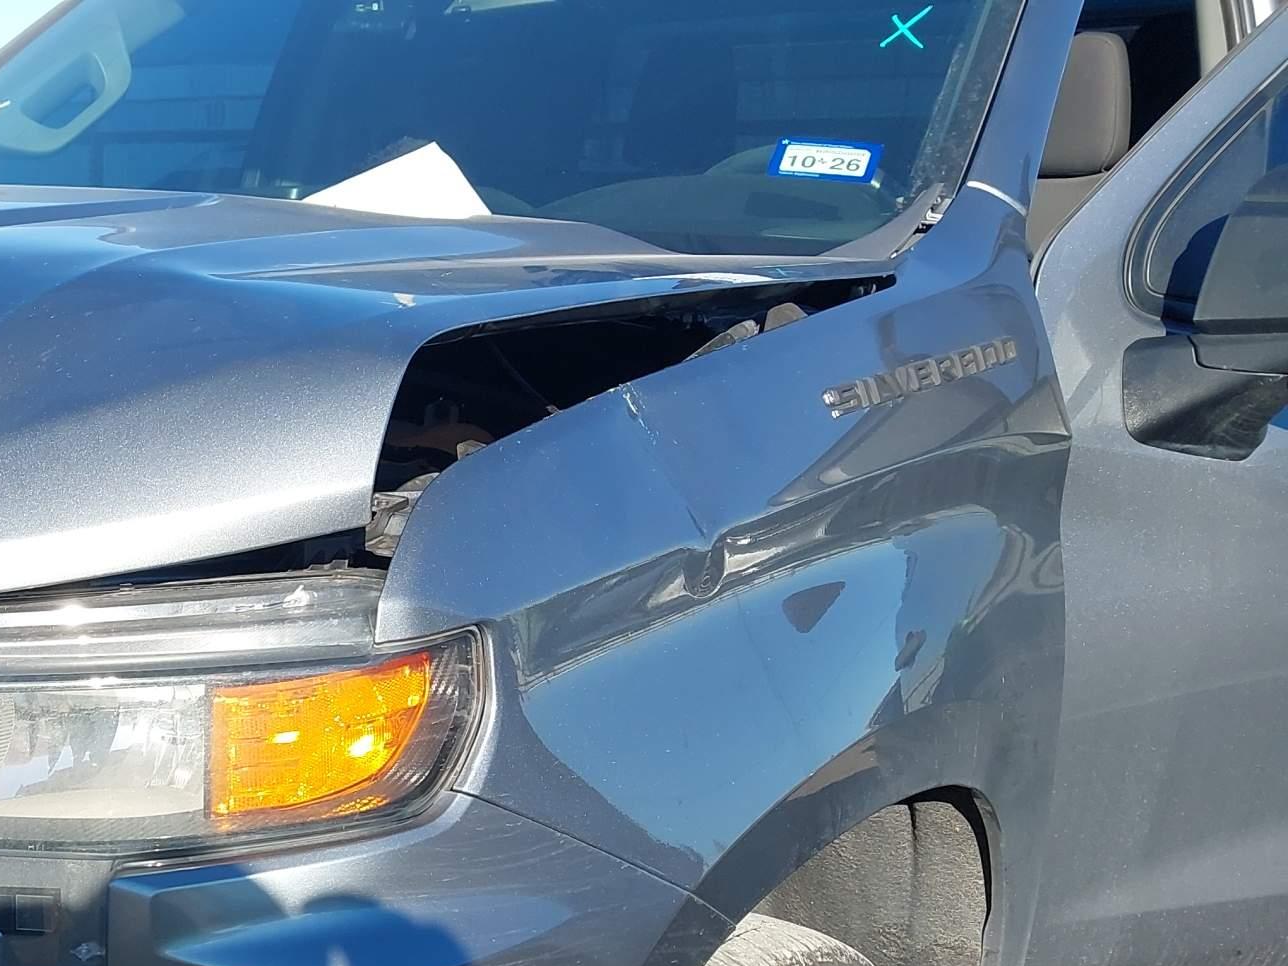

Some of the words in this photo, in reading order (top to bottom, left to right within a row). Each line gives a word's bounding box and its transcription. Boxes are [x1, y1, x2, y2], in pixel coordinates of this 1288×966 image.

[787, 155, 817, 169] 10
[829, 157, 862, 172] 26
[821, 336, 1017, 419] SILVERADO
